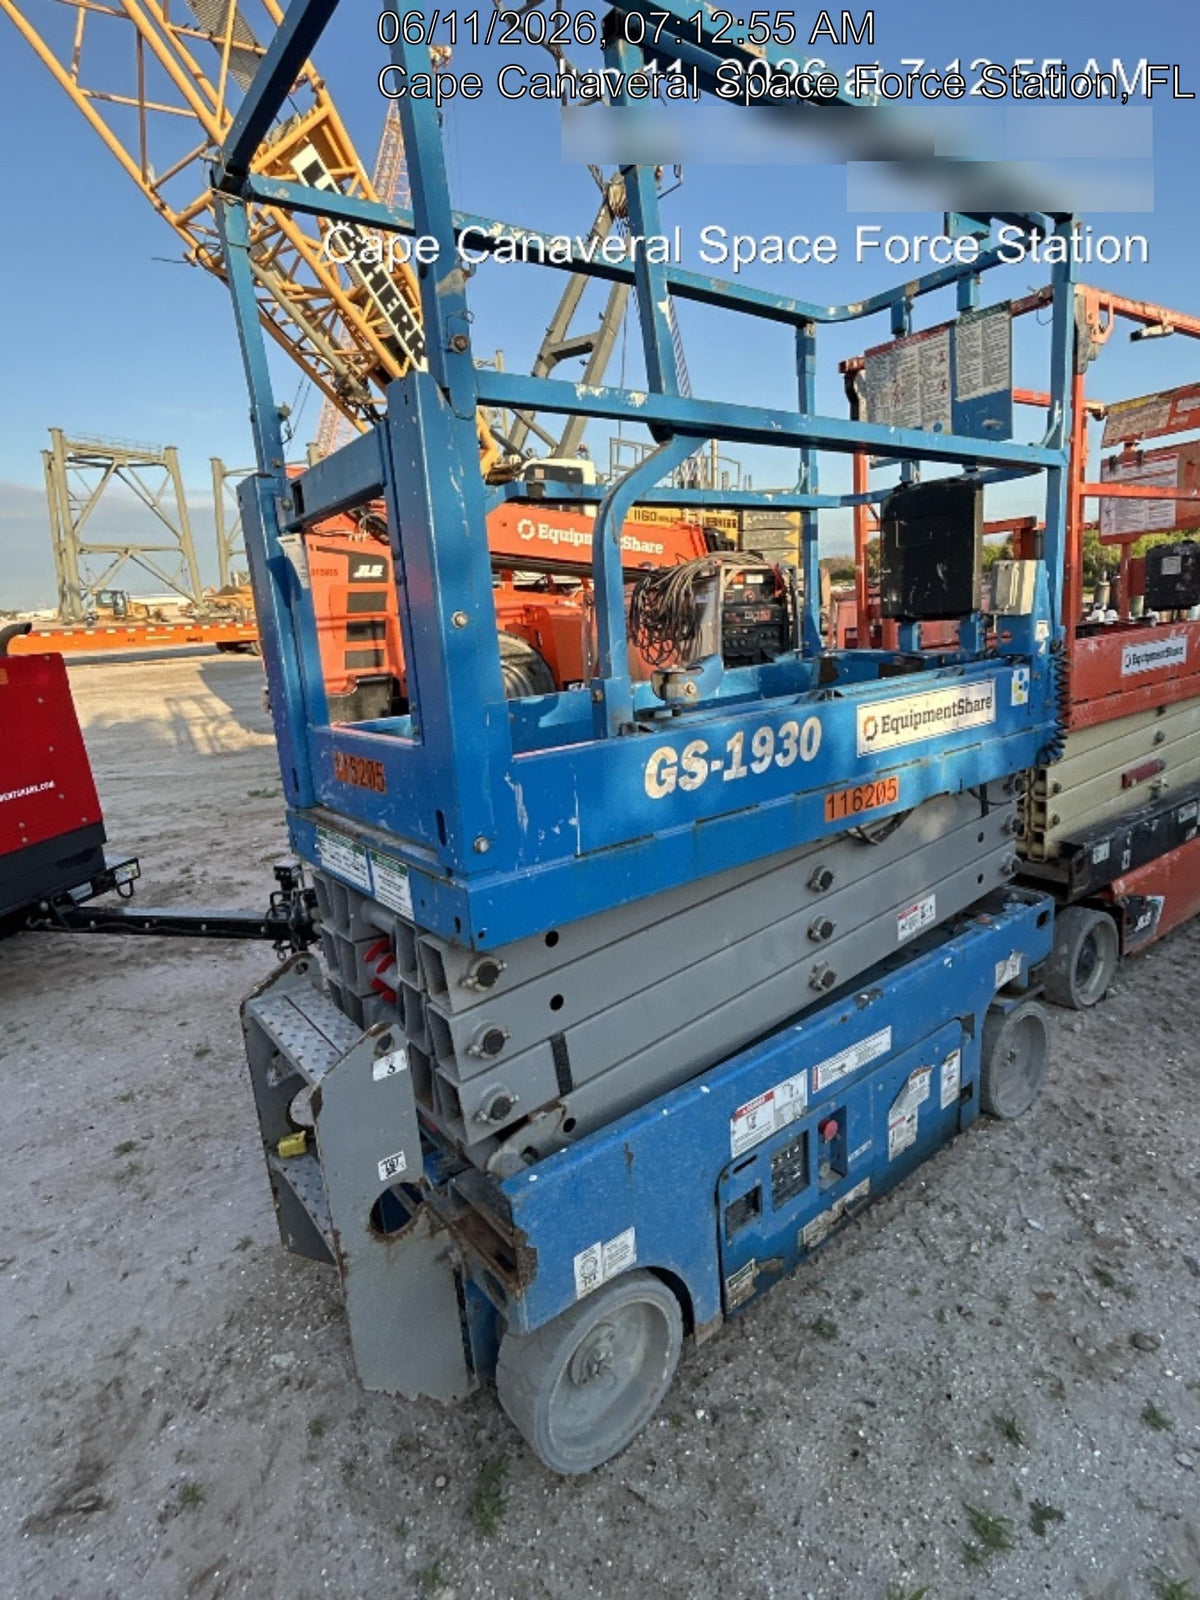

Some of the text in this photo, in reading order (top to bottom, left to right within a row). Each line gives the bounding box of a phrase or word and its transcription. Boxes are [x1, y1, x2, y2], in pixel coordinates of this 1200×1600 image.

[881, 696, 993, 735] EquipmentShare
[644, 716, 823, 799] GS-1930
[827, 778, 898, 819] 116205
